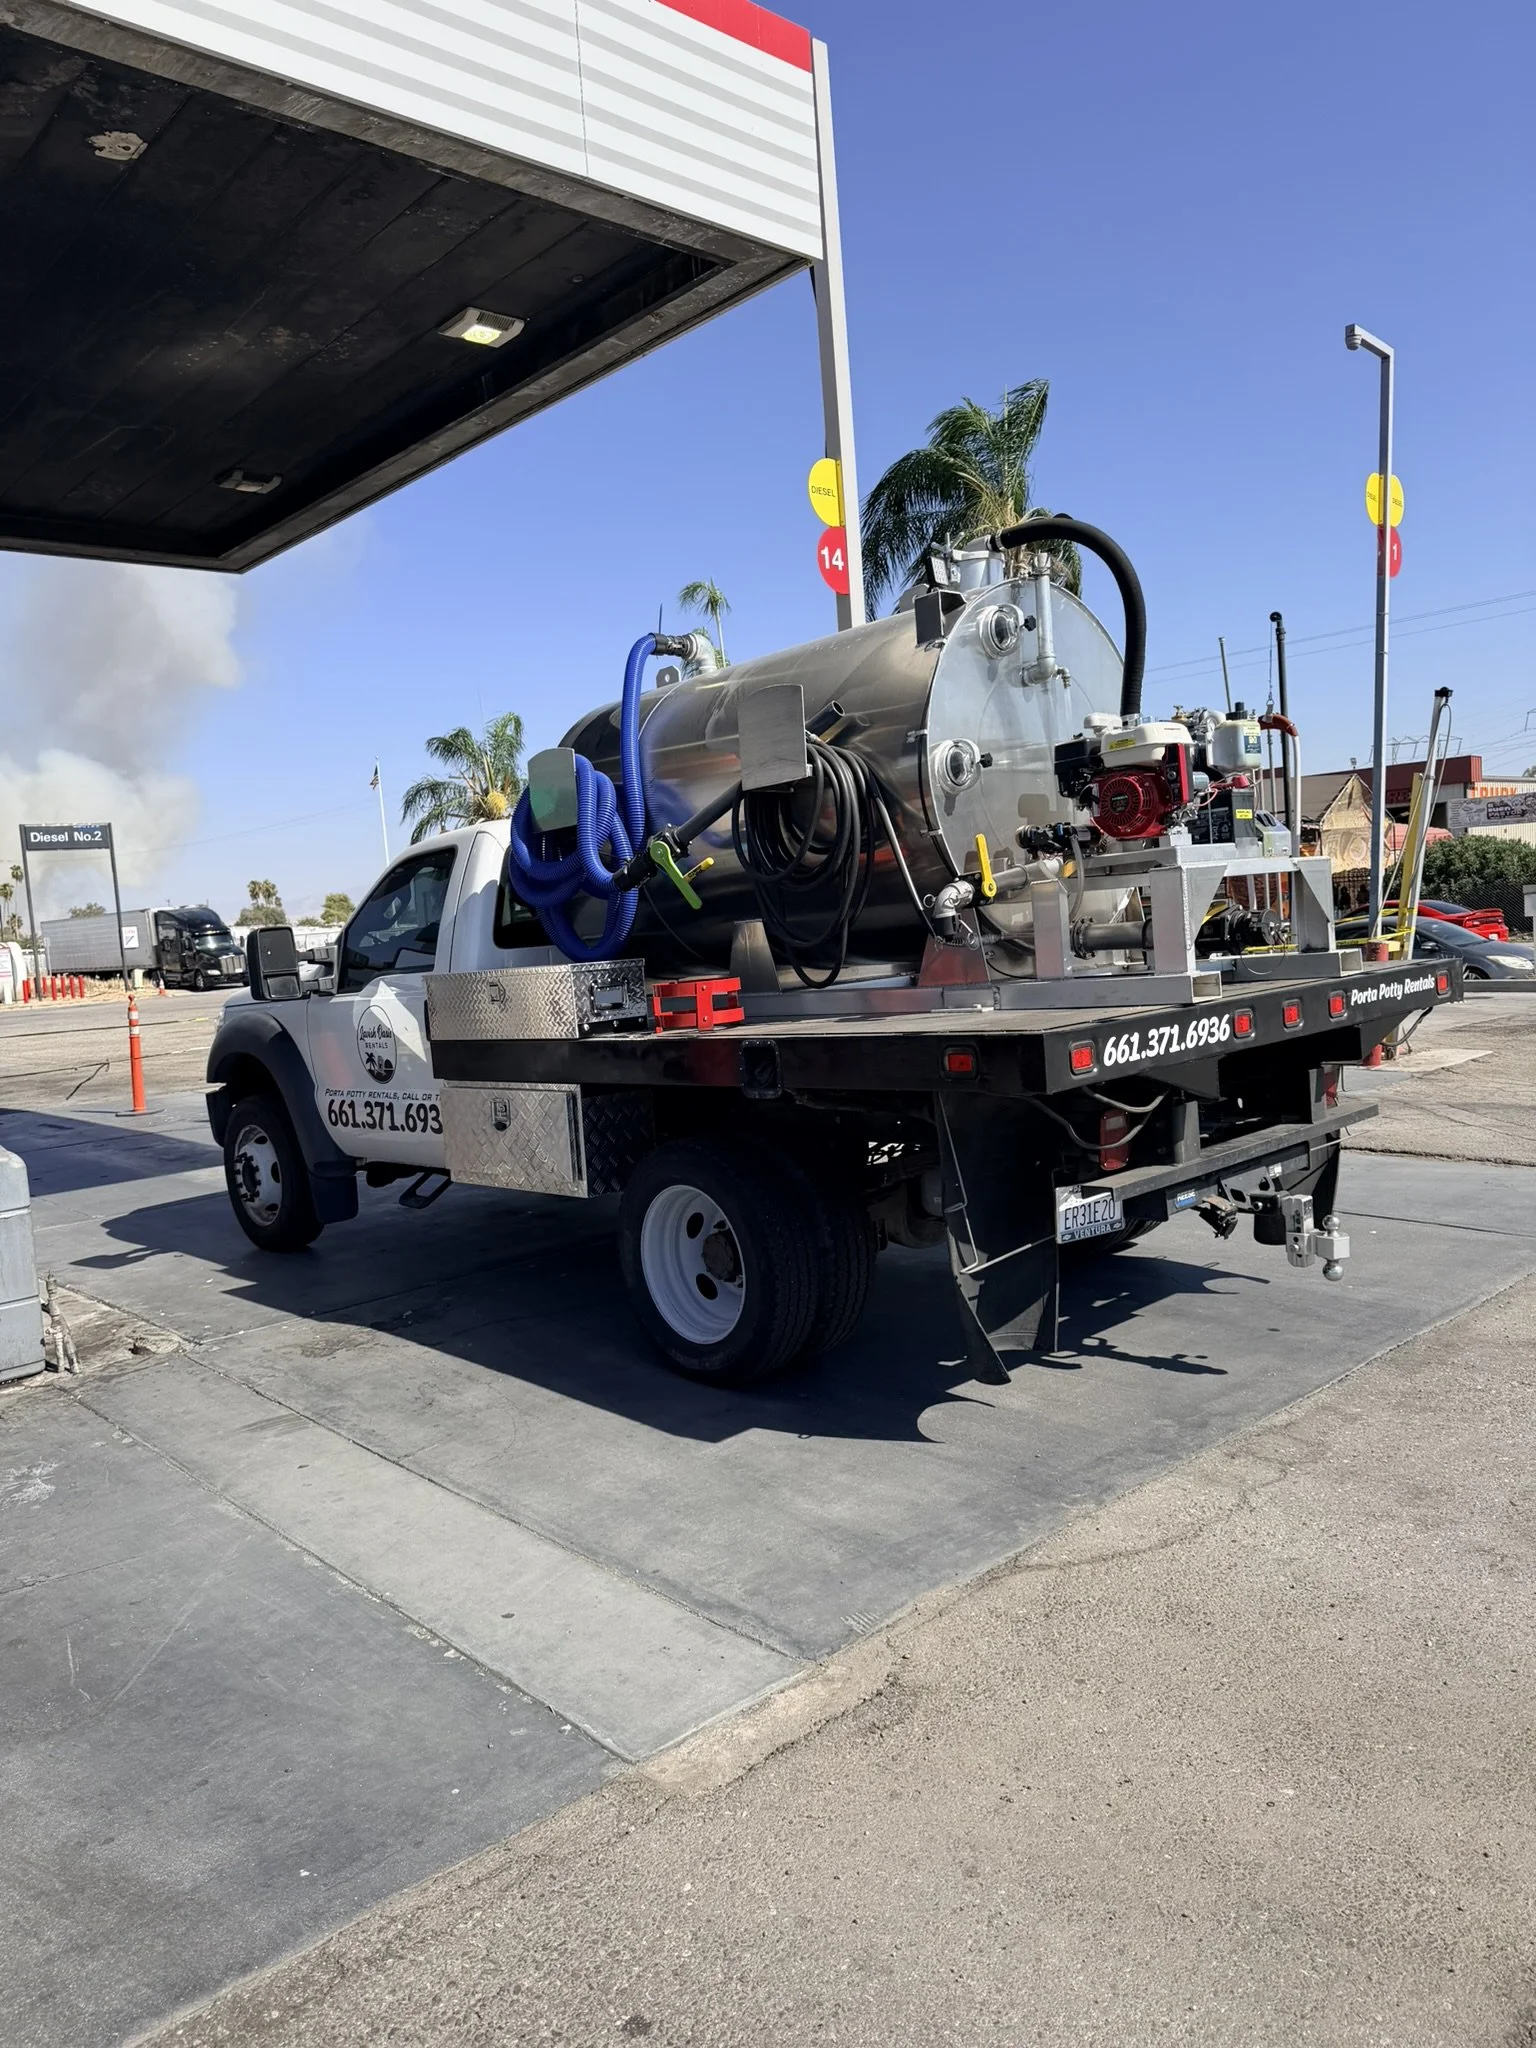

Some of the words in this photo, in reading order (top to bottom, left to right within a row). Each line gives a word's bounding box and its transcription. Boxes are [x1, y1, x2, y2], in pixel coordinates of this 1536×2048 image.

[811, 485, 836, 498] DIESEL
[820, 546, 844, 571] 14
[30, 831, 69, 843] Diesel
[73, 830, 103, 841] No.2
[1350, 987, 1378, 1006] Porta
[1379, 981, 1403, 1000] Potty
[1404, 974, 1435, 994] Rentals
[1103, 1014, 1231, 1067] 661.371.6936
[346, 1090, 367, 1098] POTTY
[402, 1092, 420, 1101] CALL
[422, 1093, 433, 1101] OR
[327, 1099, 443, 1135] 661.371.693
[1064, 1198, 1116, 1231] ER31E20
[1073, 1223, 1112, 1239] VENTURA
